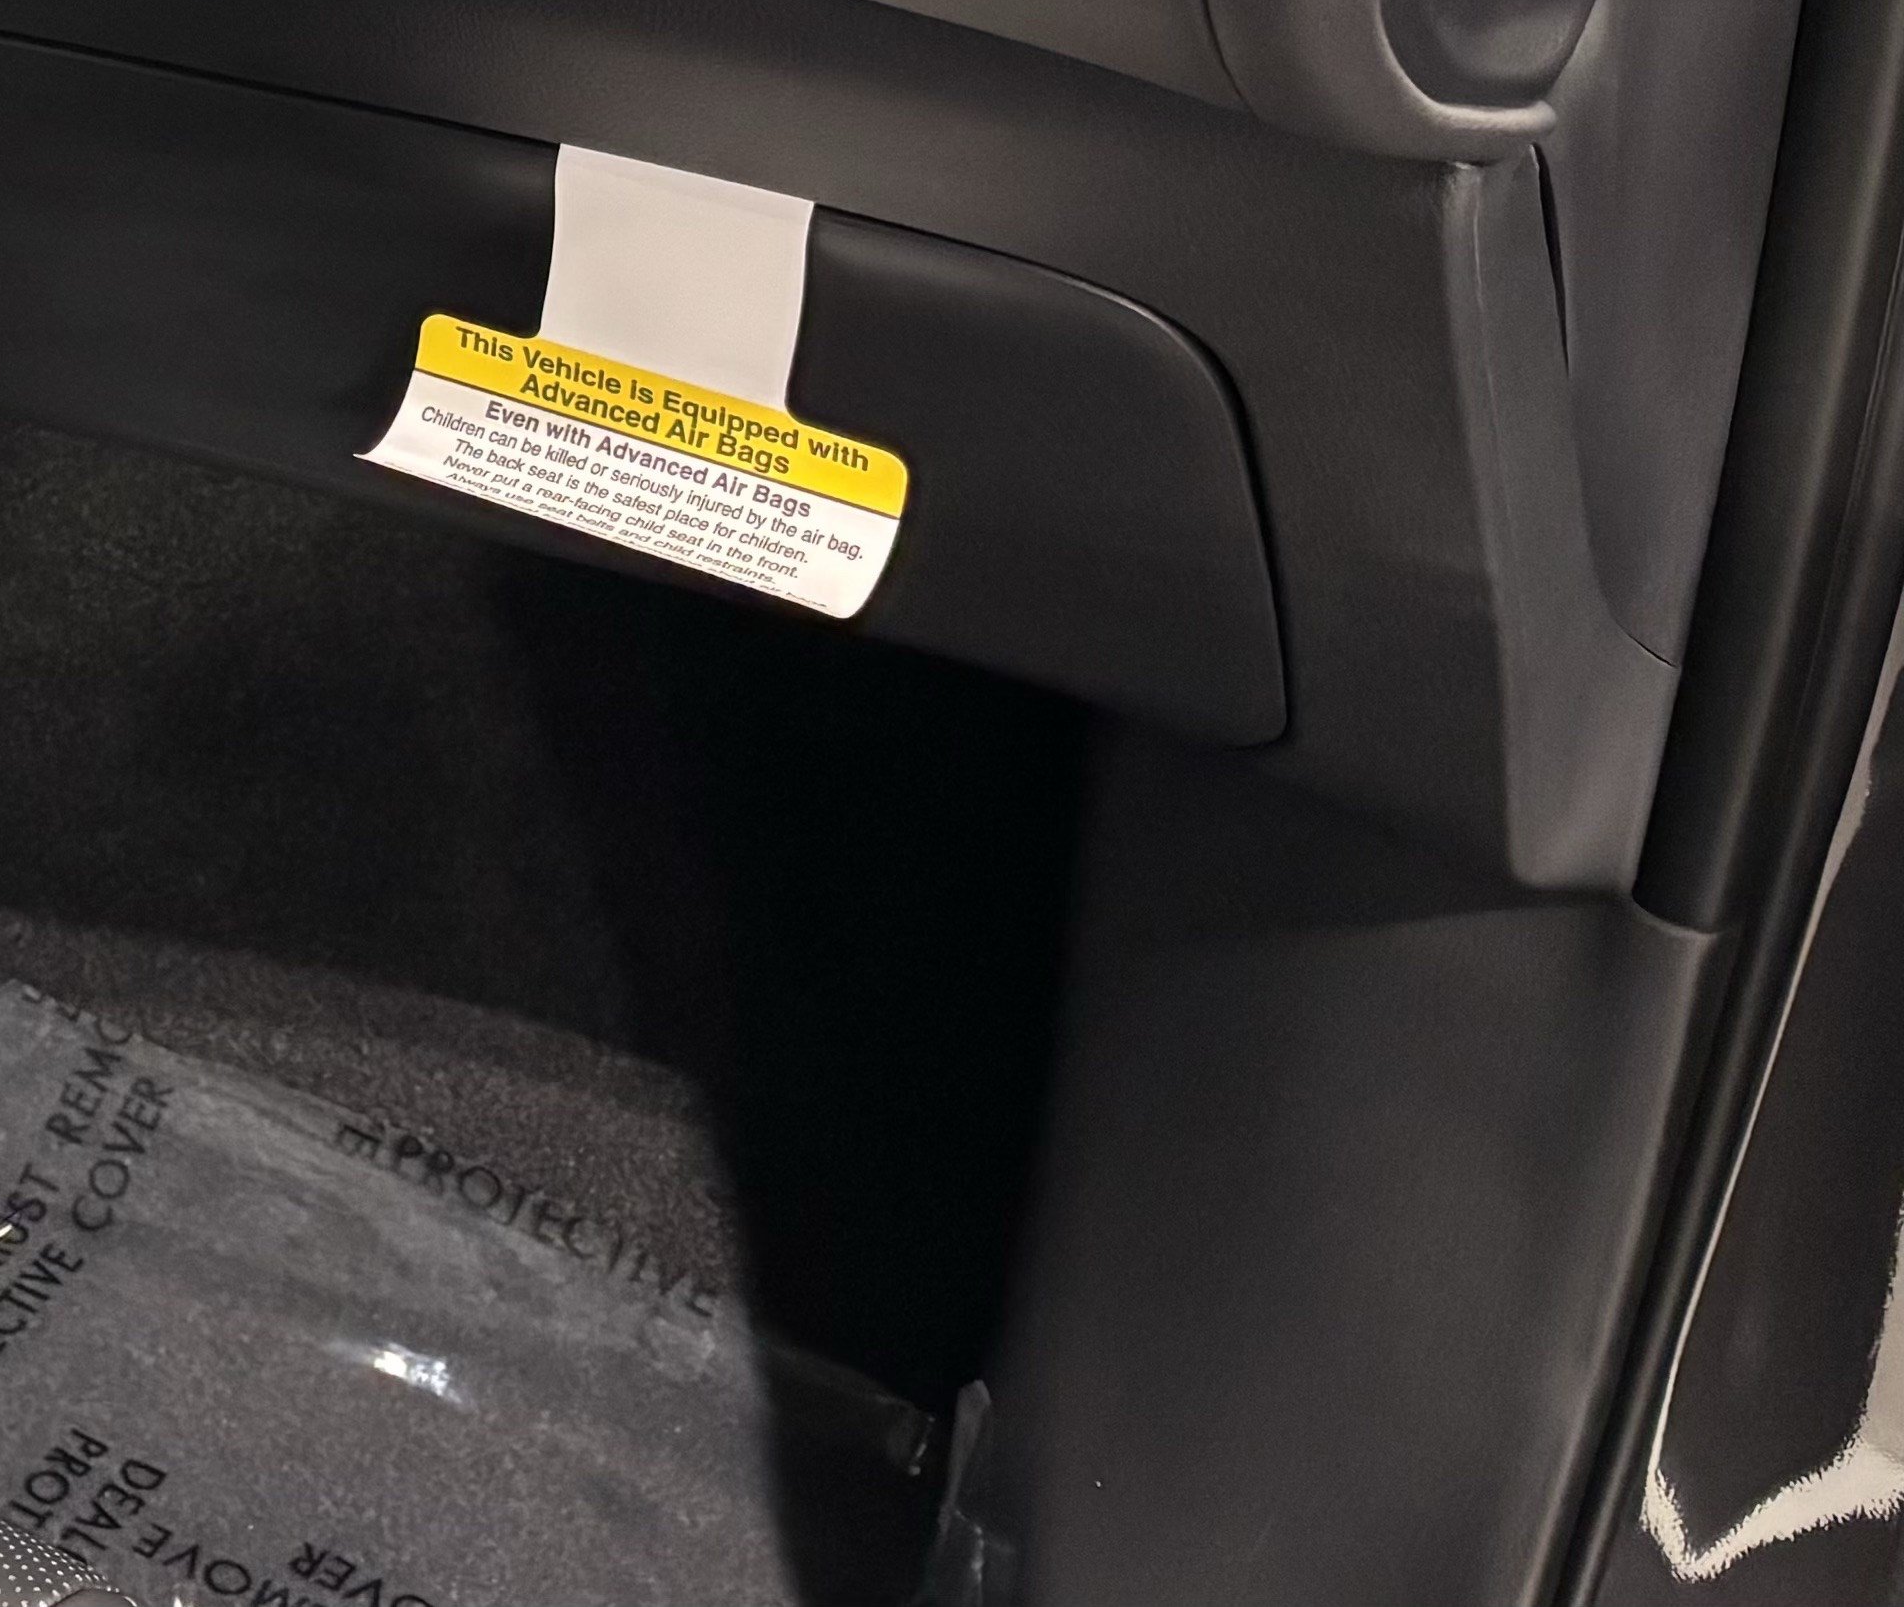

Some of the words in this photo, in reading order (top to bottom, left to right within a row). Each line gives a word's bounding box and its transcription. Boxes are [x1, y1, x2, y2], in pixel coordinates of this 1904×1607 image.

[456, 326, 514, 362] This
[522, 345, 622, 395] Vehicle
[630, 379, 655, 405] is
[662, 389, 799, 450] Equipped
[808, 438, 869, 472] with
[485, 400, 539, 432] Even
[547, 421, 591, 449] with
[595, 436, 709, 485] Advanced
[711, 472, 748, 497] Air
[752, 484, 811, 518] Bags
[519, 373, 661, 435] Advanced
[665, 419, 709, 449] Air
[716, 433, 790, 475] Bags
[421, 406, 485, 439] Children
[489, 431, 517, 450] can
[521, 436, 542, 457] be
[545, 445, 589, 471] killed
[590, 461, 608, 477] or
[610, 471, 684, 504] seriously
[686, 490, 744, 520] injured
[746, 508, 768, 529] by
[770, 516, 798, 537] the
[801, 528, 825, 545] air
[827, 533, 863, 561] bag.
[442, 455, 491, 477] Never
[492, 472, 519, 488] put
[522, 482, 533, 492] a
[536, 486, 622, 523] rear-facing
[625, 514, 666, 535] child
[667, 528, 704, 548] seat
[707, 540, 722, 554] in
[726, 546, 753, 563] the
[756, 555, 799, 579] front.
[456, 438, 484, 459] The
[486, 449, 525, 473] back
[528, 464, 561, 485] seat
[566, 474, 579, 490] is
[584, 480, 609, 499] the
[612, 493, 663, 517] safest
[663, 507, 709, 532] place
[713, 520, 736, 539] for
[739, 528, 808, 564] children.
[618, 528, 652, 542] and
[653, 540, 694, 557] child
[71, 1075, 175, 1233] COVER
